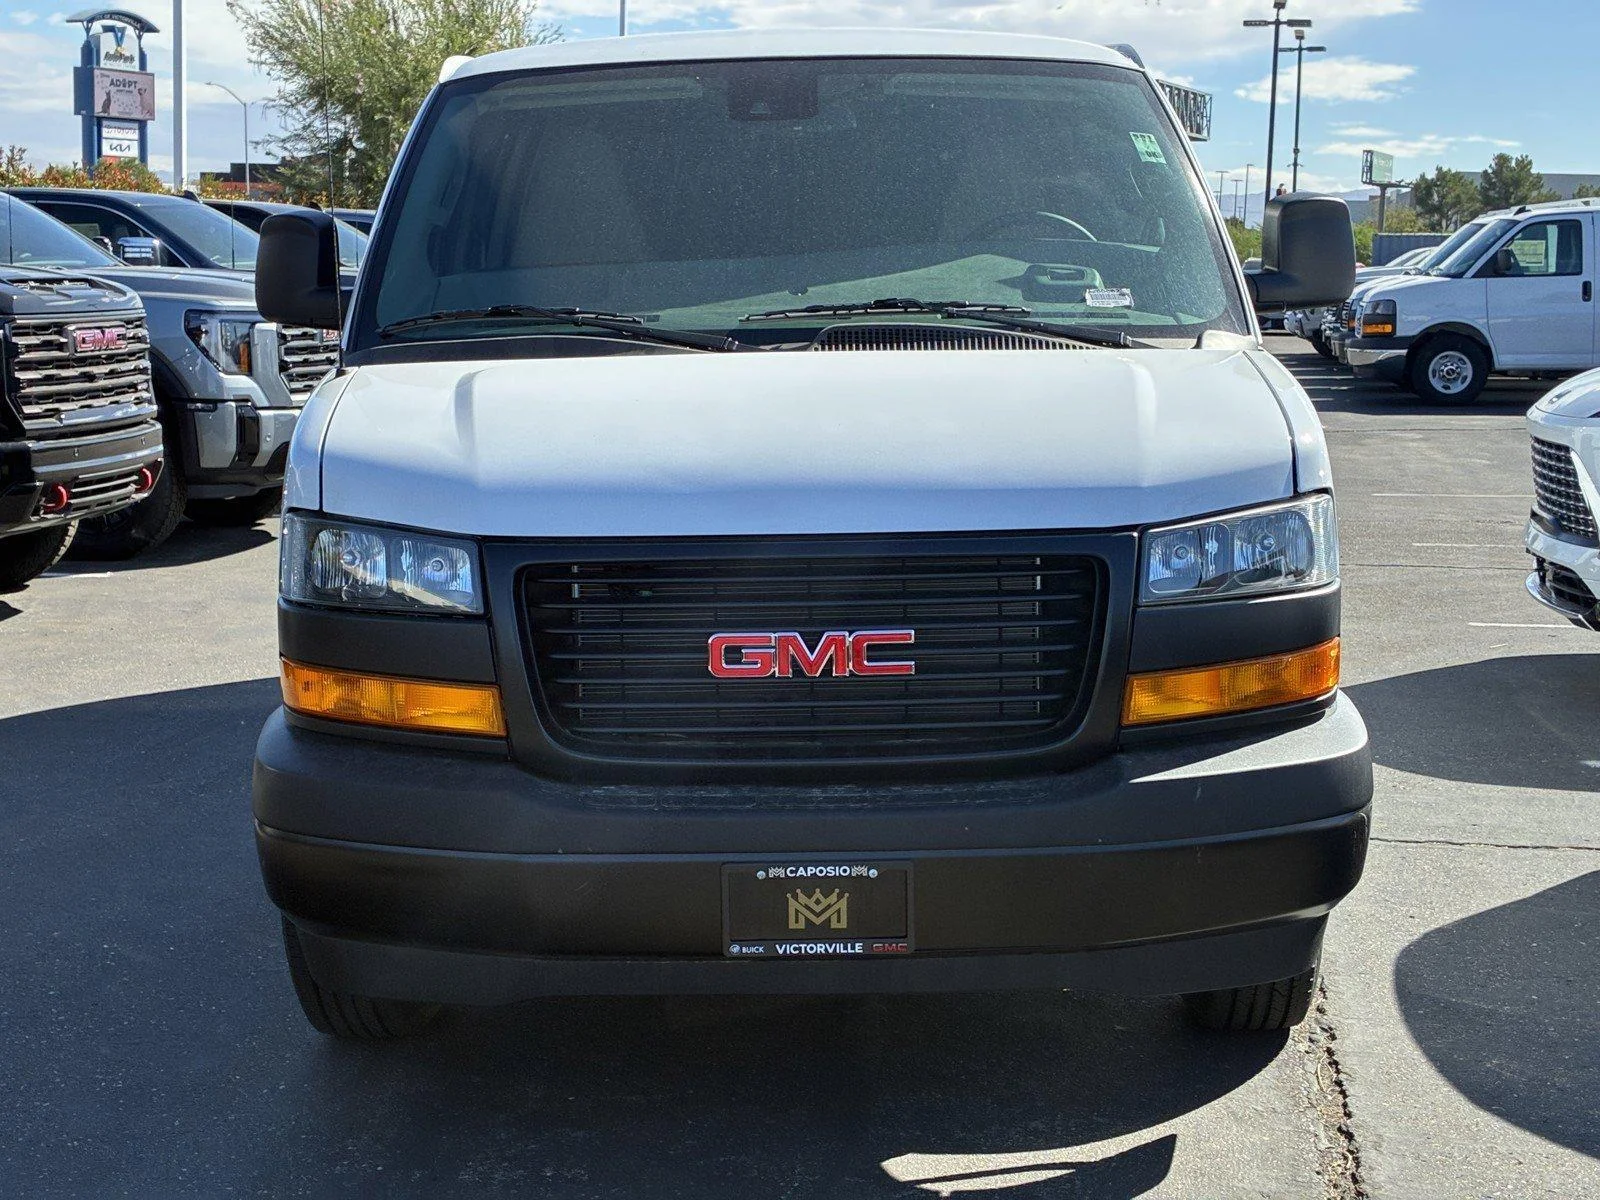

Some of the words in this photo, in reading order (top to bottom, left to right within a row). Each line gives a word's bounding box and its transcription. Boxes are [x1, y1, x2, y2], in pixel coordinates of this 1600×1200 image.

[109, 78, 138, 89] ADOPT
[75, 327, 126, 350] GMC
[708, 629, 915, 677] GMC
[786, 865, 851, 877] CAPOSIO
[742, 946, 764, 954] BUICK
[775, 943, 864, 955] VICTORVILLE
[872, 943, 908, 952] GMC
